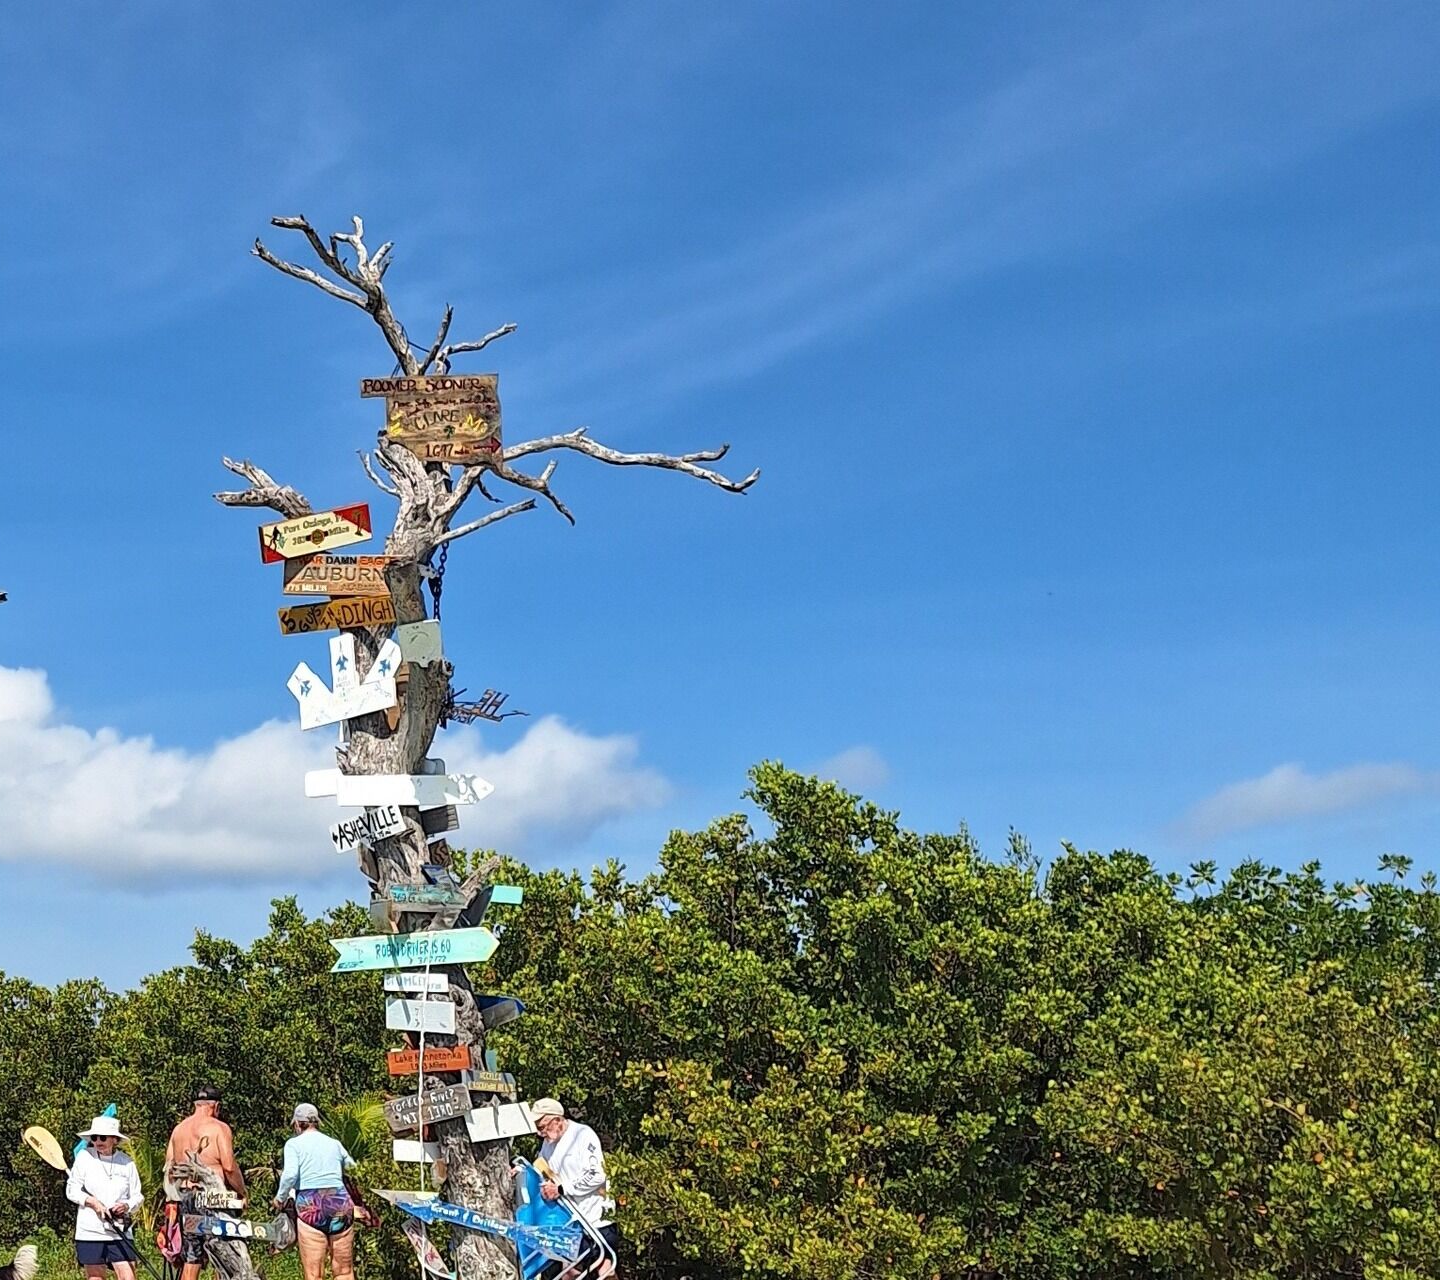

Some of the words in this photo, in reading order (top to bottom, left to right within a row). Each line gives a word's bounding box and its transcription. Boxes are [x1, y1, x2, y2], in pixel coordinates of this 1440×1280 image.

[325, 556, 357, 566] DAMN
[301, 567, 384, 581] AUBURN
[338, 806, 398, 849] ASHEVILLE
